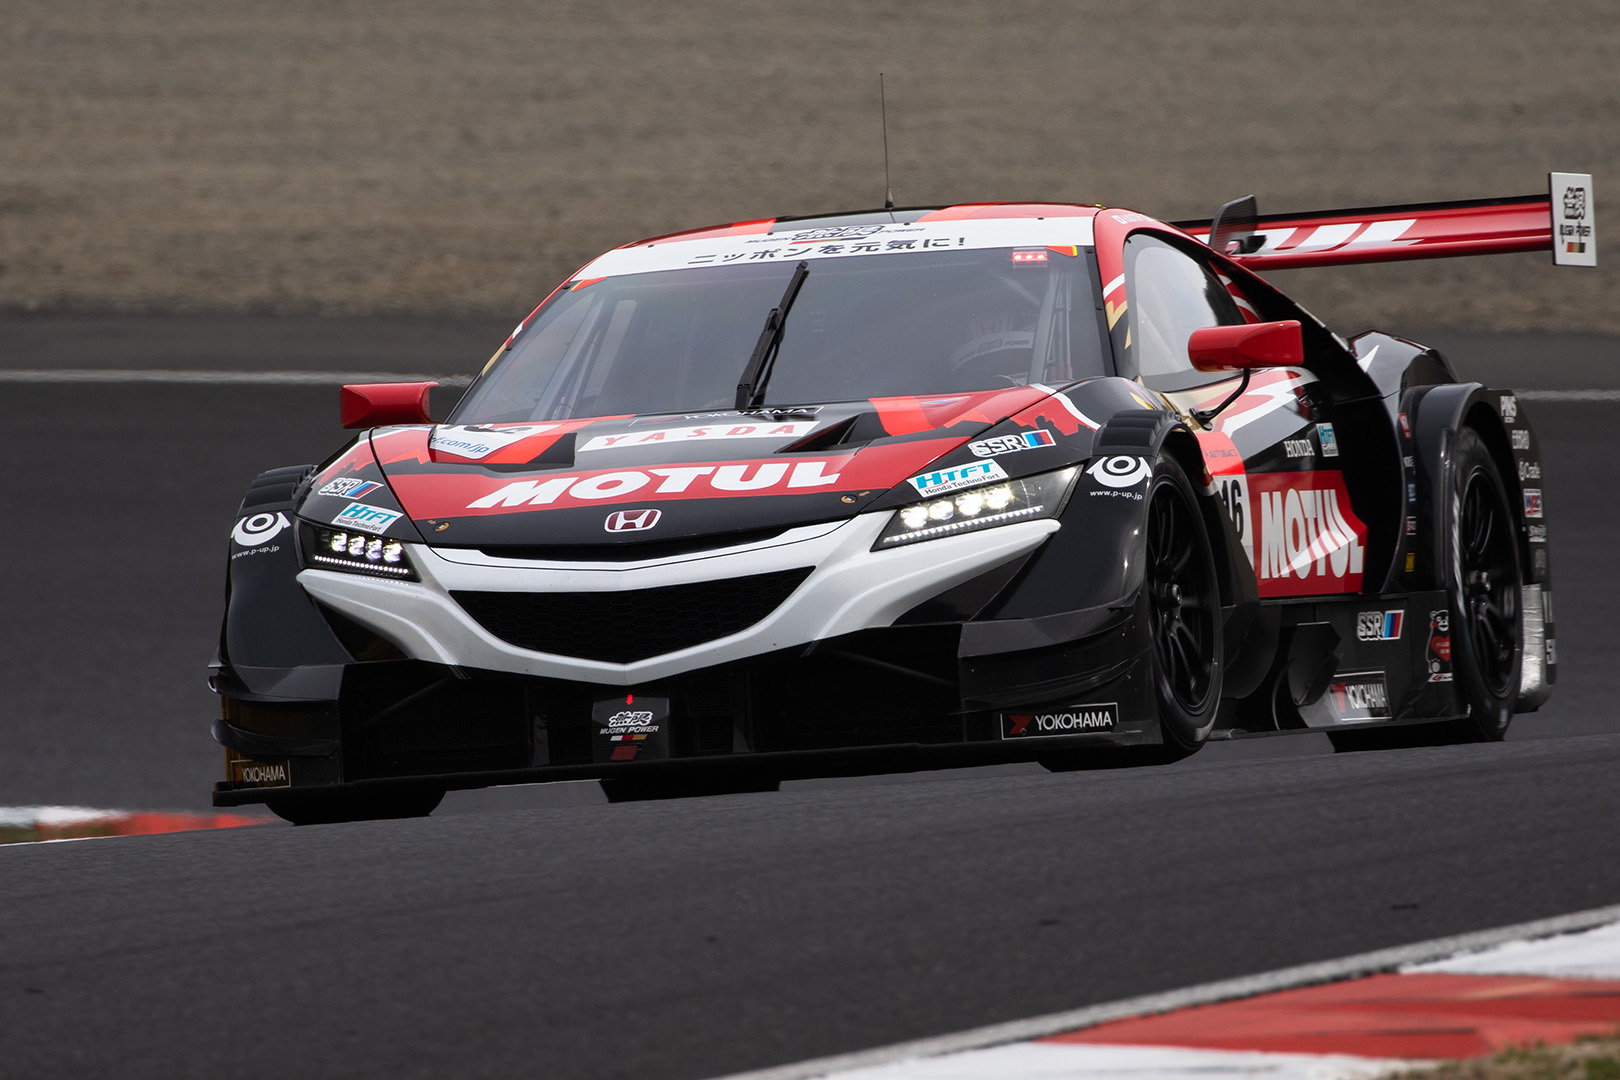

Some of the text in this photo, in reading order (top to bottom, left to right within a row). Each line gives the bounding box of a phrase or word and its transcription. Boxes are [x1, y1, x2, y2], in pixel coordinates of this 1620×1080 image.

[602, 424, 797, 447] YASDA
[969, 434, 1025, 458] SSR
[1283, 438, 1316, 458] HONDA
[466, 460, 841, 509] MOTUL
[915, 461, 995, 490] HTFT
[1089, 490, 1143, 501] www.p-up.jp
[340, 504, 398, 525] HTFT
[1260, 487, 1365, 580] MOTUL
[1358, 611, 1387, 641] SSR
[599, 725, 660, 735] MUGEN POWER
[1034, 710, 1113, 731] YOKOHAMA
[241, 764, 286, 783] YOKOHAMA
